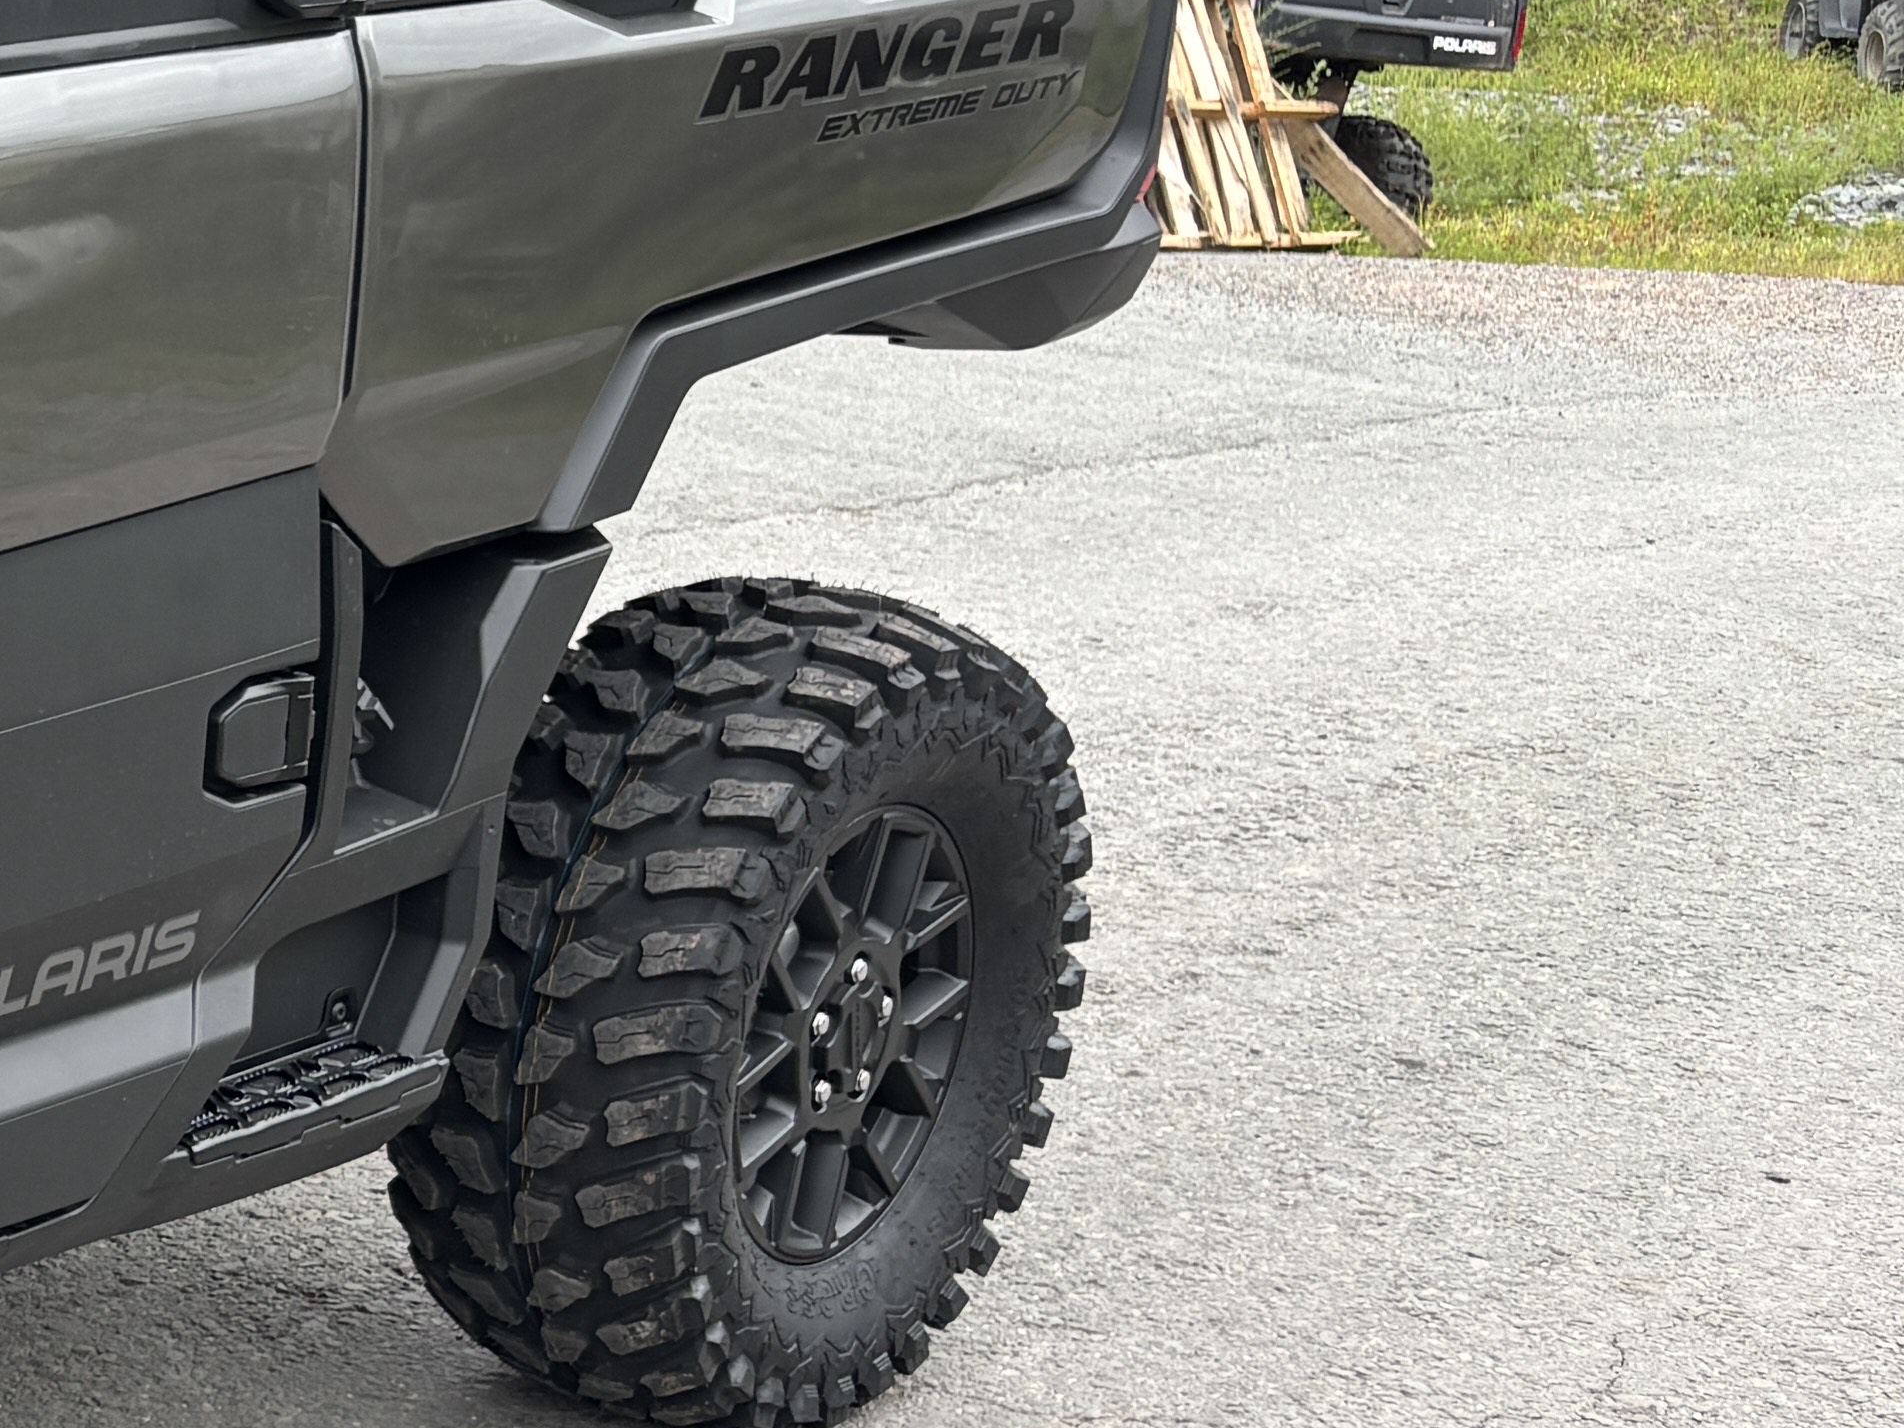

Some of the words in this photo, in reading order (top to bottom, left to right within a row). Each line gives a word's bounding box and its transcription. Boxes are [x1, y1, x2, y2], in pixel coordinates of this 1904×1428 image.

[1432, 35, 1497, 56] POLARIS
[816, 88, 986, 145] EXTREME
[991, 69, 1080, 111] DUTY
